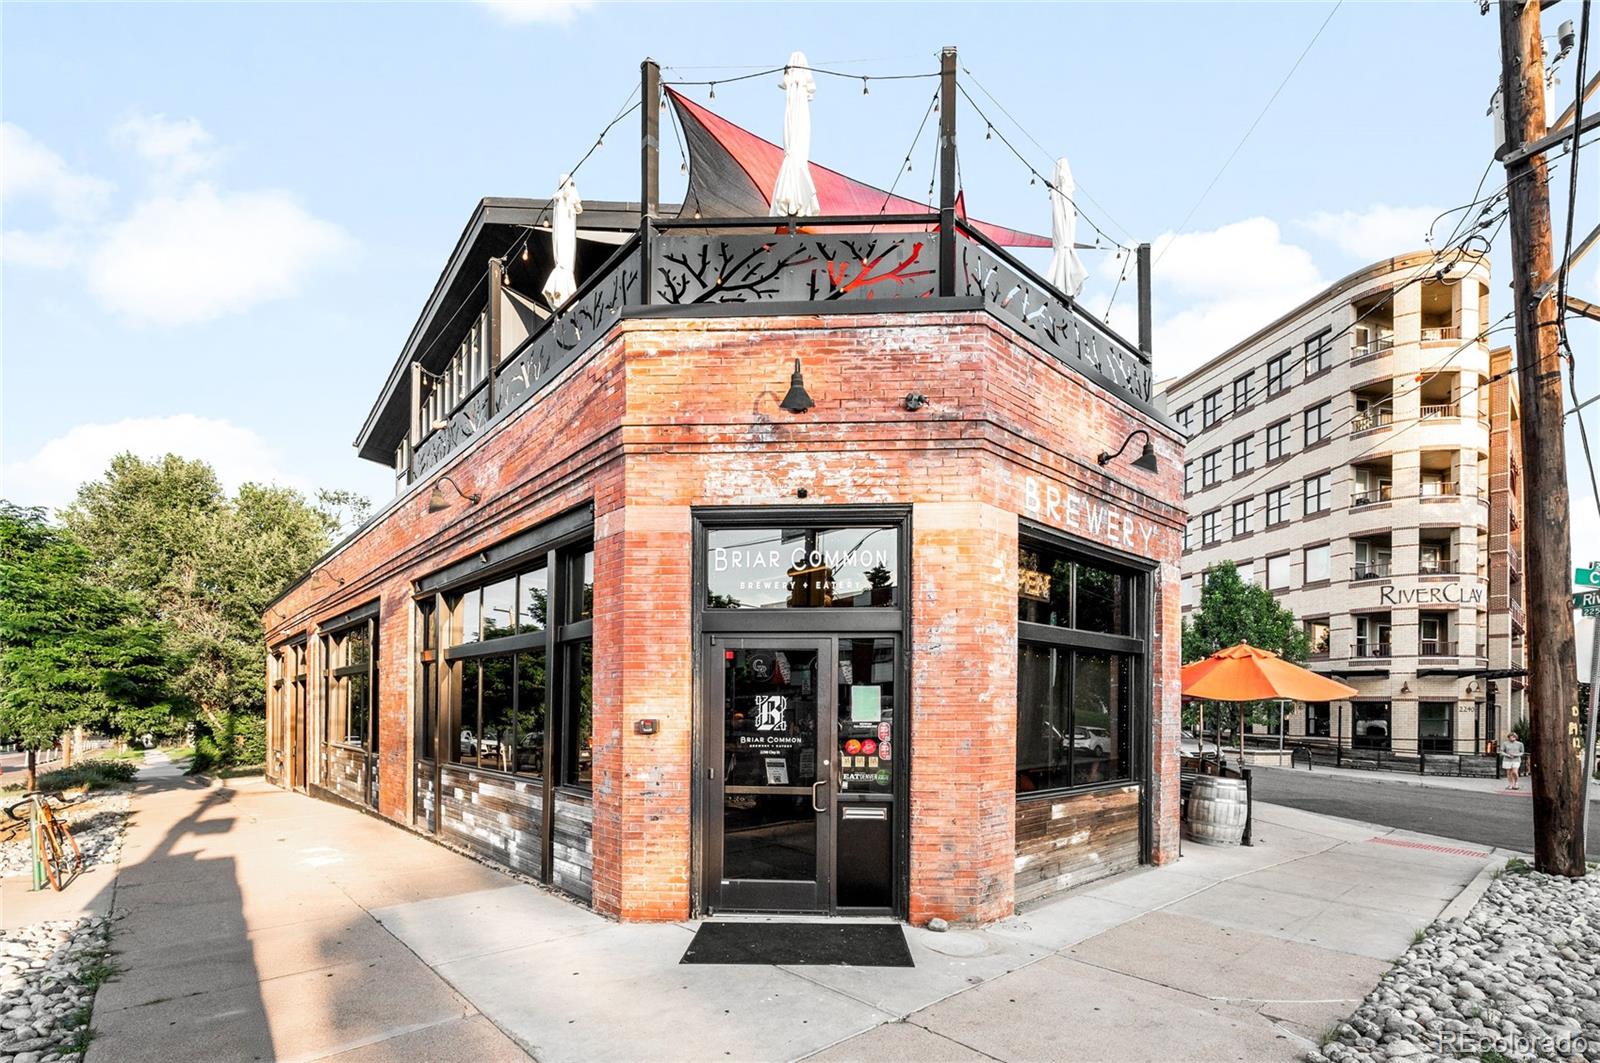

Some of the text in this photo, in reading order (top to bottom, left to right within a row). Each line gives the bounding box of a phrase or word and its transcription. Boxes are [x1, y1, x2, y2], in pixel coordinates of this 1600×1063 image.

[1024, 475, 1153, 552] BREWERY
[714, 547, 888, 571] BRIAR COMMON
[740, 581, 861, 590] BREWERY EATERY
